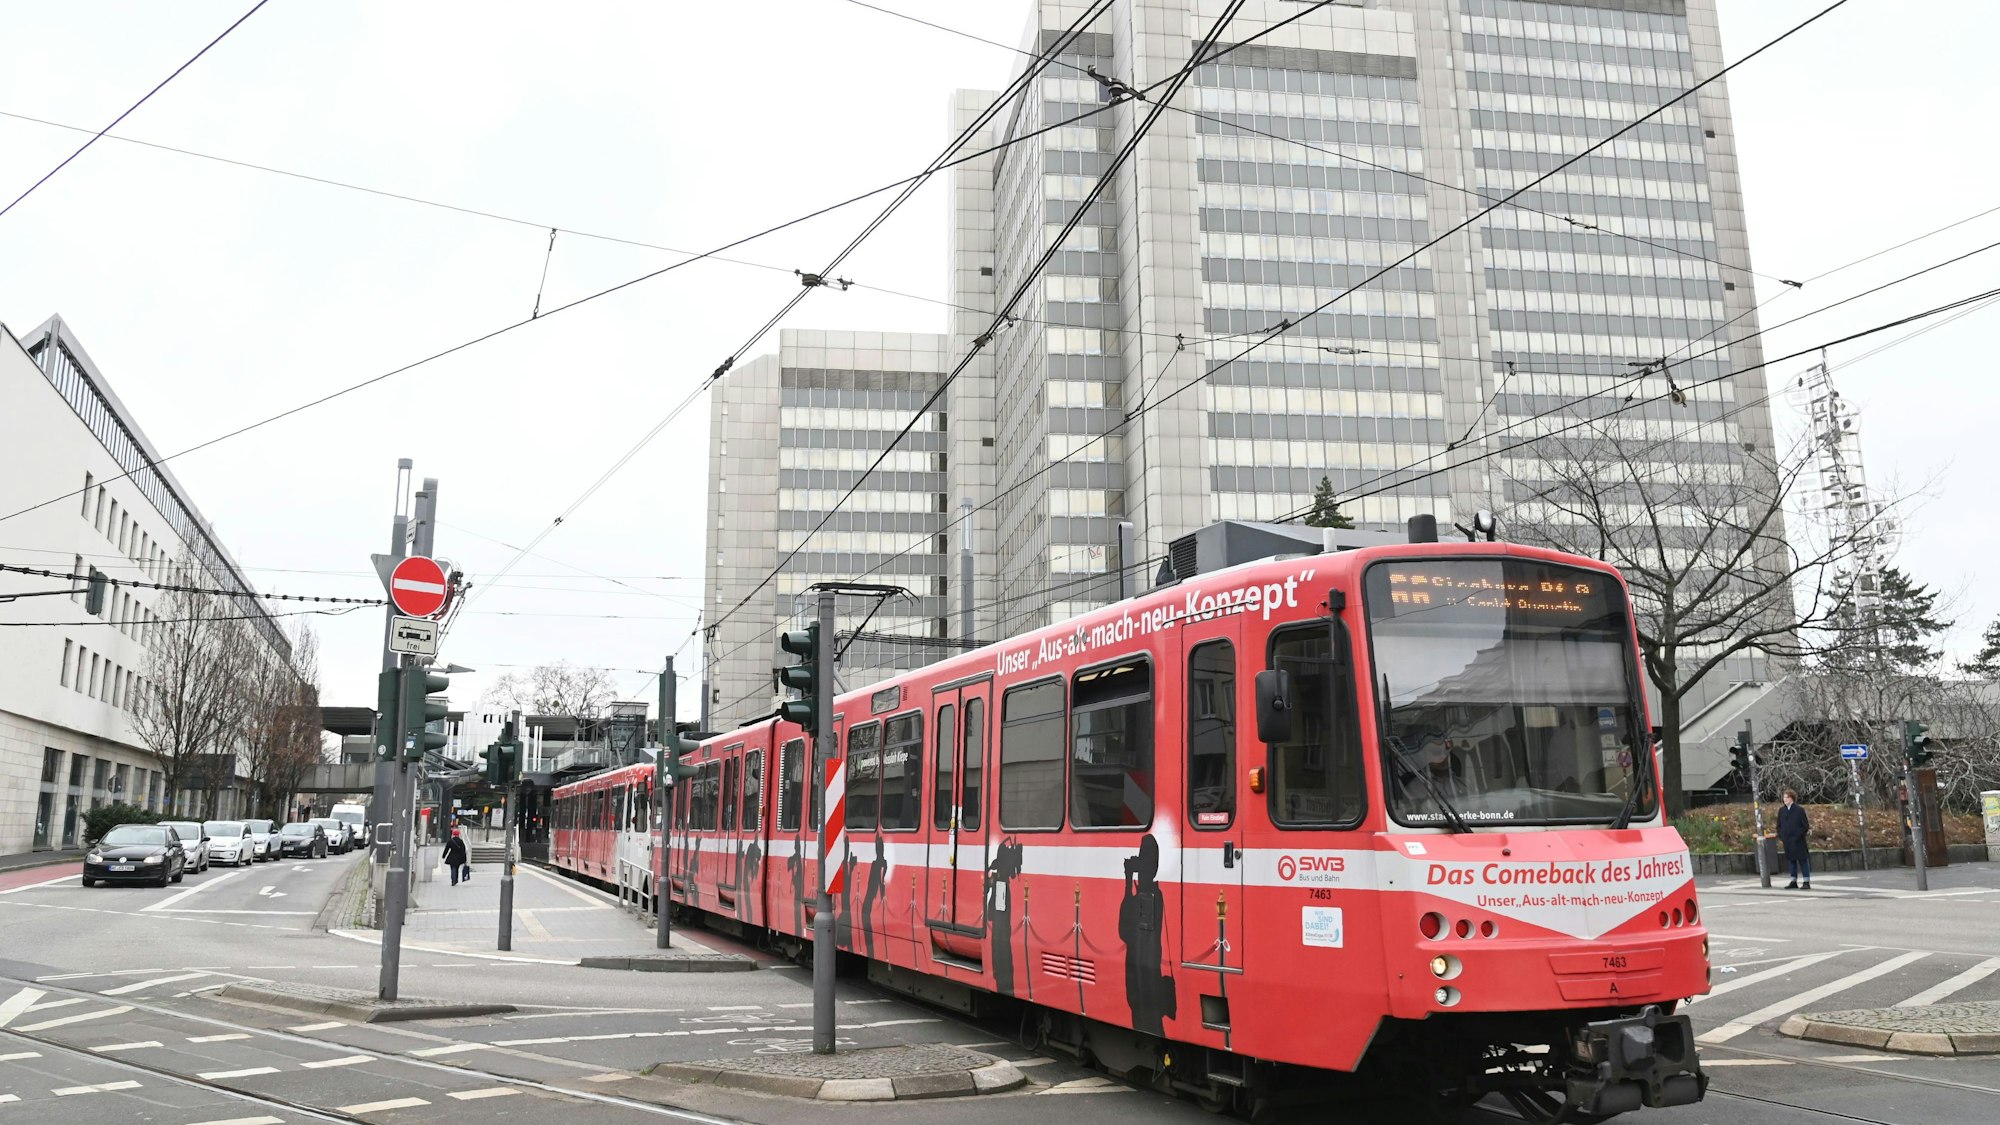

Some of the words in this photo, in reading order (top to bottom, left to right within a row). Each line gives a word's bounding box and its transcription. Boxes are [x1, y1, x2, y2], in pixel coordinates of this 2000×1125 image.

[406, 641, 420, 650] frei
[997, 649, 1031, 676] Unser
[1406, 810, 1514, 821] www.stadterke-bonn.de
[1299, 856, 1345, 871] SWB
[1427, 864, 1475, 885] Das
[1482, 861, 1597, 885] Comeback
[1601, 861, 1631, 882] des
[1635, 855, 1685, 881] Jahres!
[1299, 874, 1310, 882] Bus
[1311, 874, 1323, 882] und
[1325, 874, 1340, 882] Bahn
[1309, 888, 1332, 900] 7463
[1602, 956, 1627, 969] 7463
[1610, 982, 1618, 993] A
